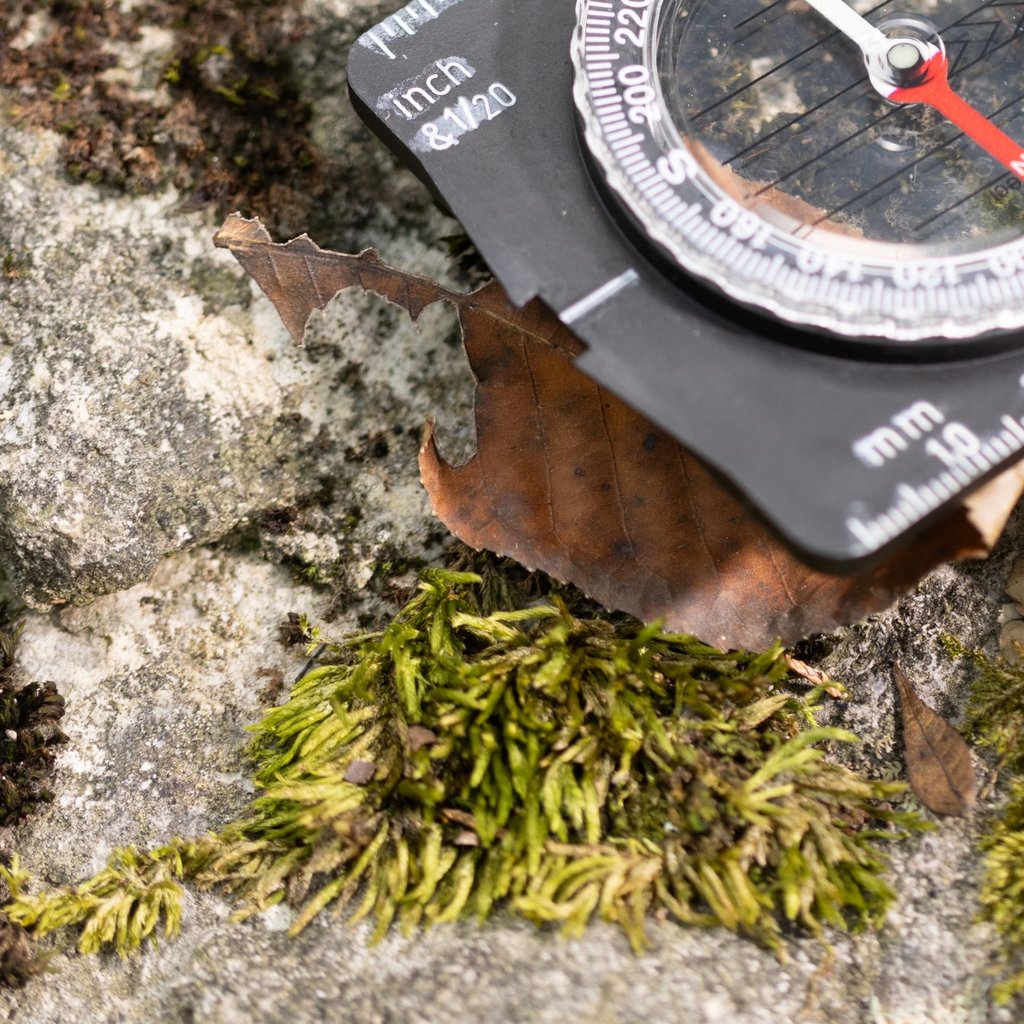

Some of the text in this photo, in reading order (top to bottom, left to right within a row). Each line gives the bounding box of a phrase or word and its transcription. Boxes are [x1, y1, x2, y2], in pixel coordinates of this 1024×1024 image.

[390, 59, 473, 118] inch
[618, 64, 660, 124] 200
[656, 148, 698, 185] S
[710, 199, 773, 250] 160
[853, 401, 945, 467] mm
[925, 422, 981, 466] 10
